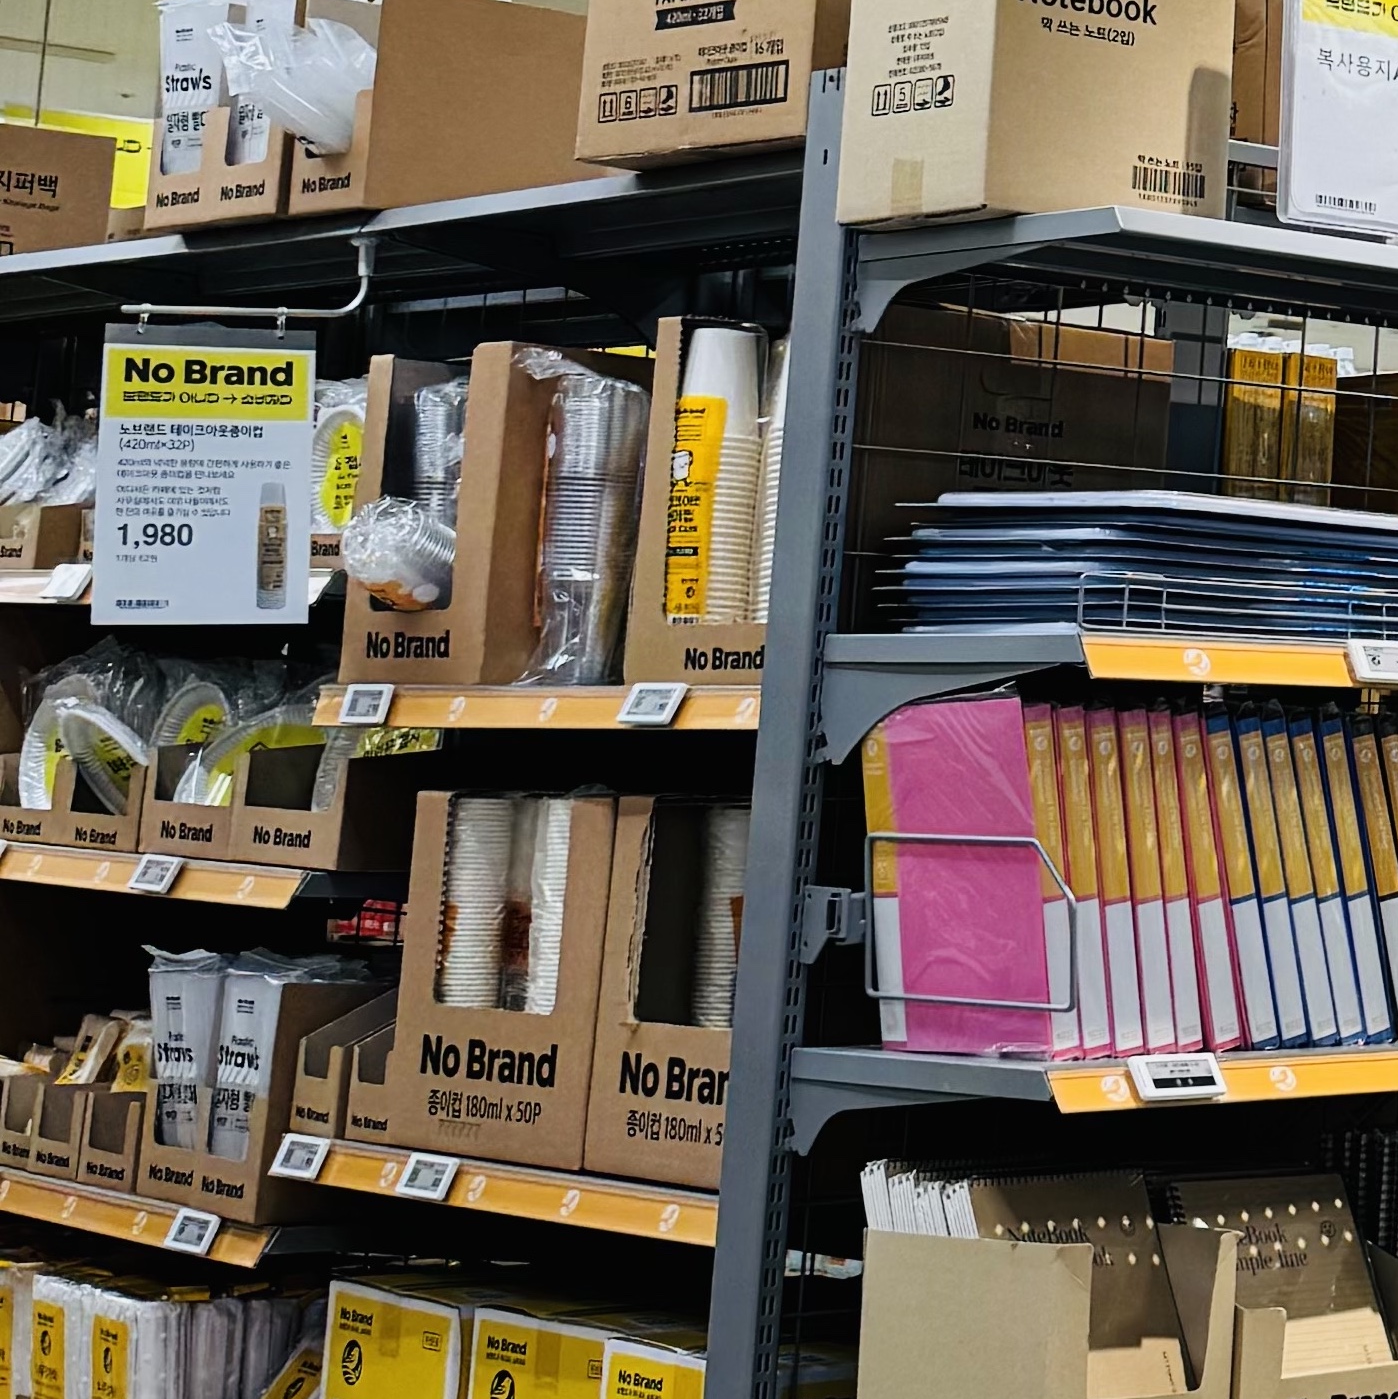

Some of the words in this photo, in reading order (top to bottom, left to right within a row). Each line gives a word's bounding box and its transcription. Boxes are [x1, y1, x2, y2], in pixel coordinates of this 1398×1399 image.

[165, 68, 212, 93] Straws
[124, 357, 175, 384] No
[184, 361, 294, 387] Brand
[116, 522, 194, 549] 1,980
[419, 1034, 460, 1076] No
[466, 1038, 558, 1088] Brand
[619, 1051, 660, 1097] No
[428, 1089, 462, 1120] 종이컵
[464, 1093, 502, 1123] 180ml
[516, 1098, 542, 1124] 50P
